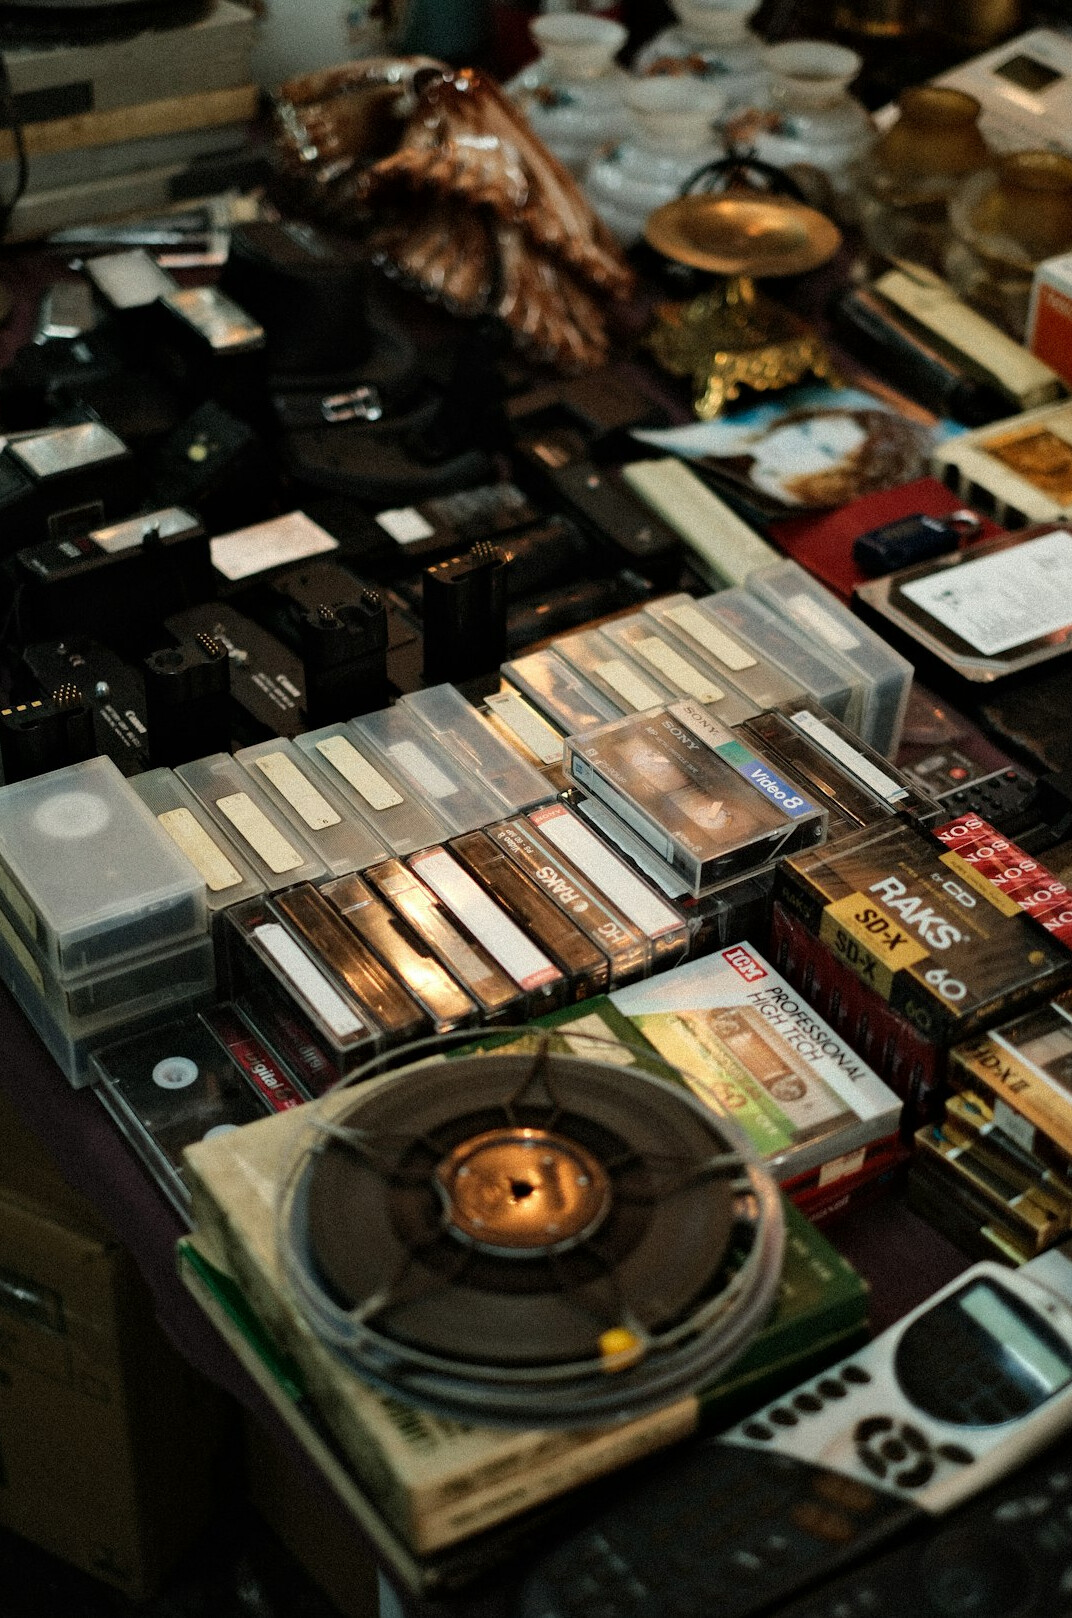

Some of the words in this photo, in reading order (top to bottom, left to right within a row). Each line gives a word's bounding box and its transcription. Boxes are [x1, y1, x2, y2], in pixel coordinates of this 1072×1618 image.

[661, 720, 699, 750] SONY
[684, 706, 719, 737] SONY
[751, 768, 786, 800] Video
[783, 796, 804, 809] 8
[535, 866, 580, 904] RAKS
[942, 881, 976, 908] CD
[854, 908, 908, 951] SD-X
[869, 876, 961, 949] RAKS
[835, 930, 875, 980] SD-X
[925, 968, 967, 1000] 60
[747, 991, 787, 1025] HIGH
[782, 1026, 824, 1062] TECH
[765, 986, 866, 1082] PROFESSIONAL
